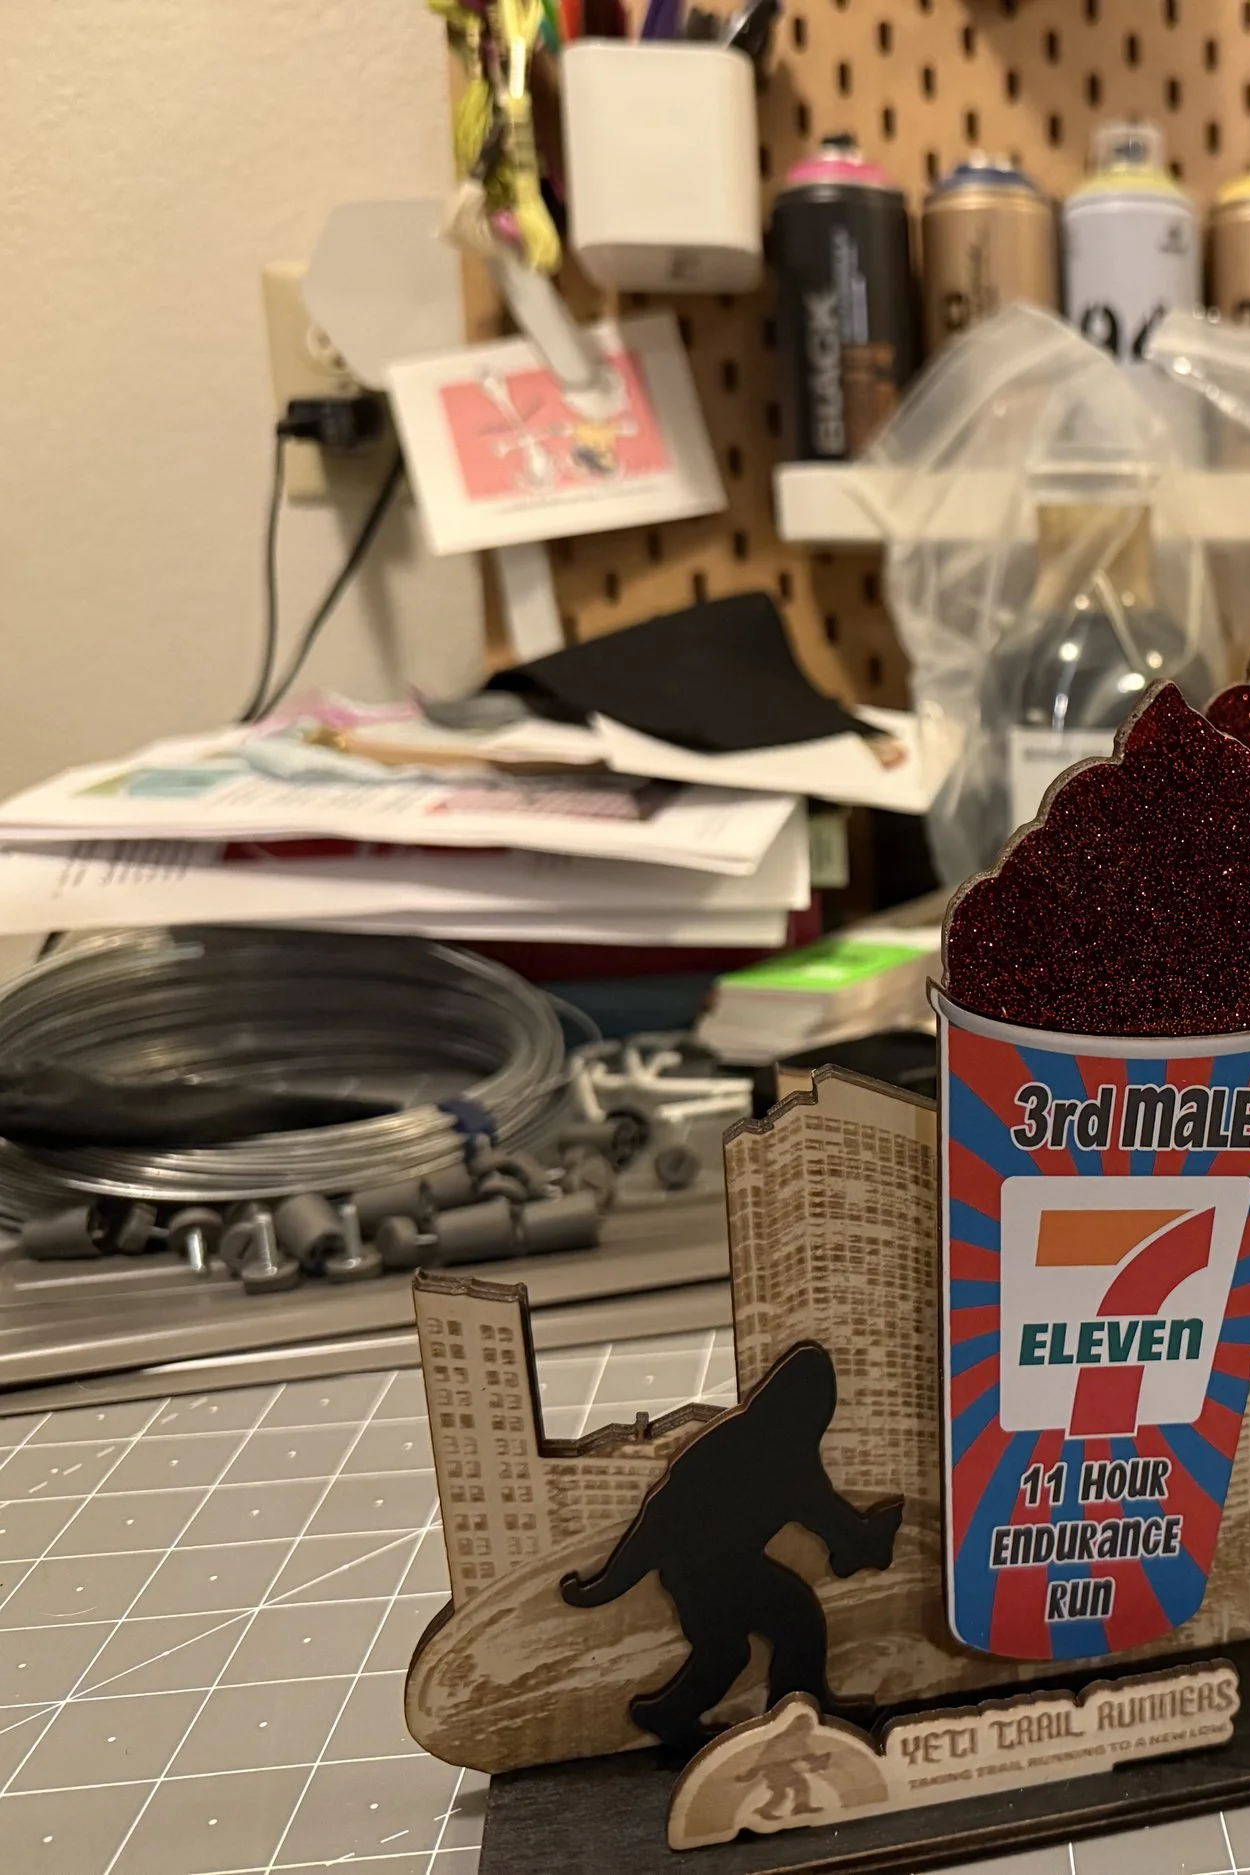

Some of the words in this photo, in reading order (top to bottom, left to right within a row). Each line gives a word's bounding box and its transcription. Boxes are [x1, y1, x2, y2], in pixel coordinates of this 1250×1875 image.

[808, 290, 845, 456] BLACK
[1011, 1082, 1117, 1150] 3rd
[1035, 1206, 1216, 1436] 7
[1021, 1463, 1068, 1507] 11
[1078, 1457, 1172, 1504] HOUR
[901, 1727, 978, 1766] YETI
[988, 1710, 1086, 1750] TRAIL
[1096, 1679, 1234, 1732] RUNNERS
[1149, 1728, 1188, 1746] NEW
